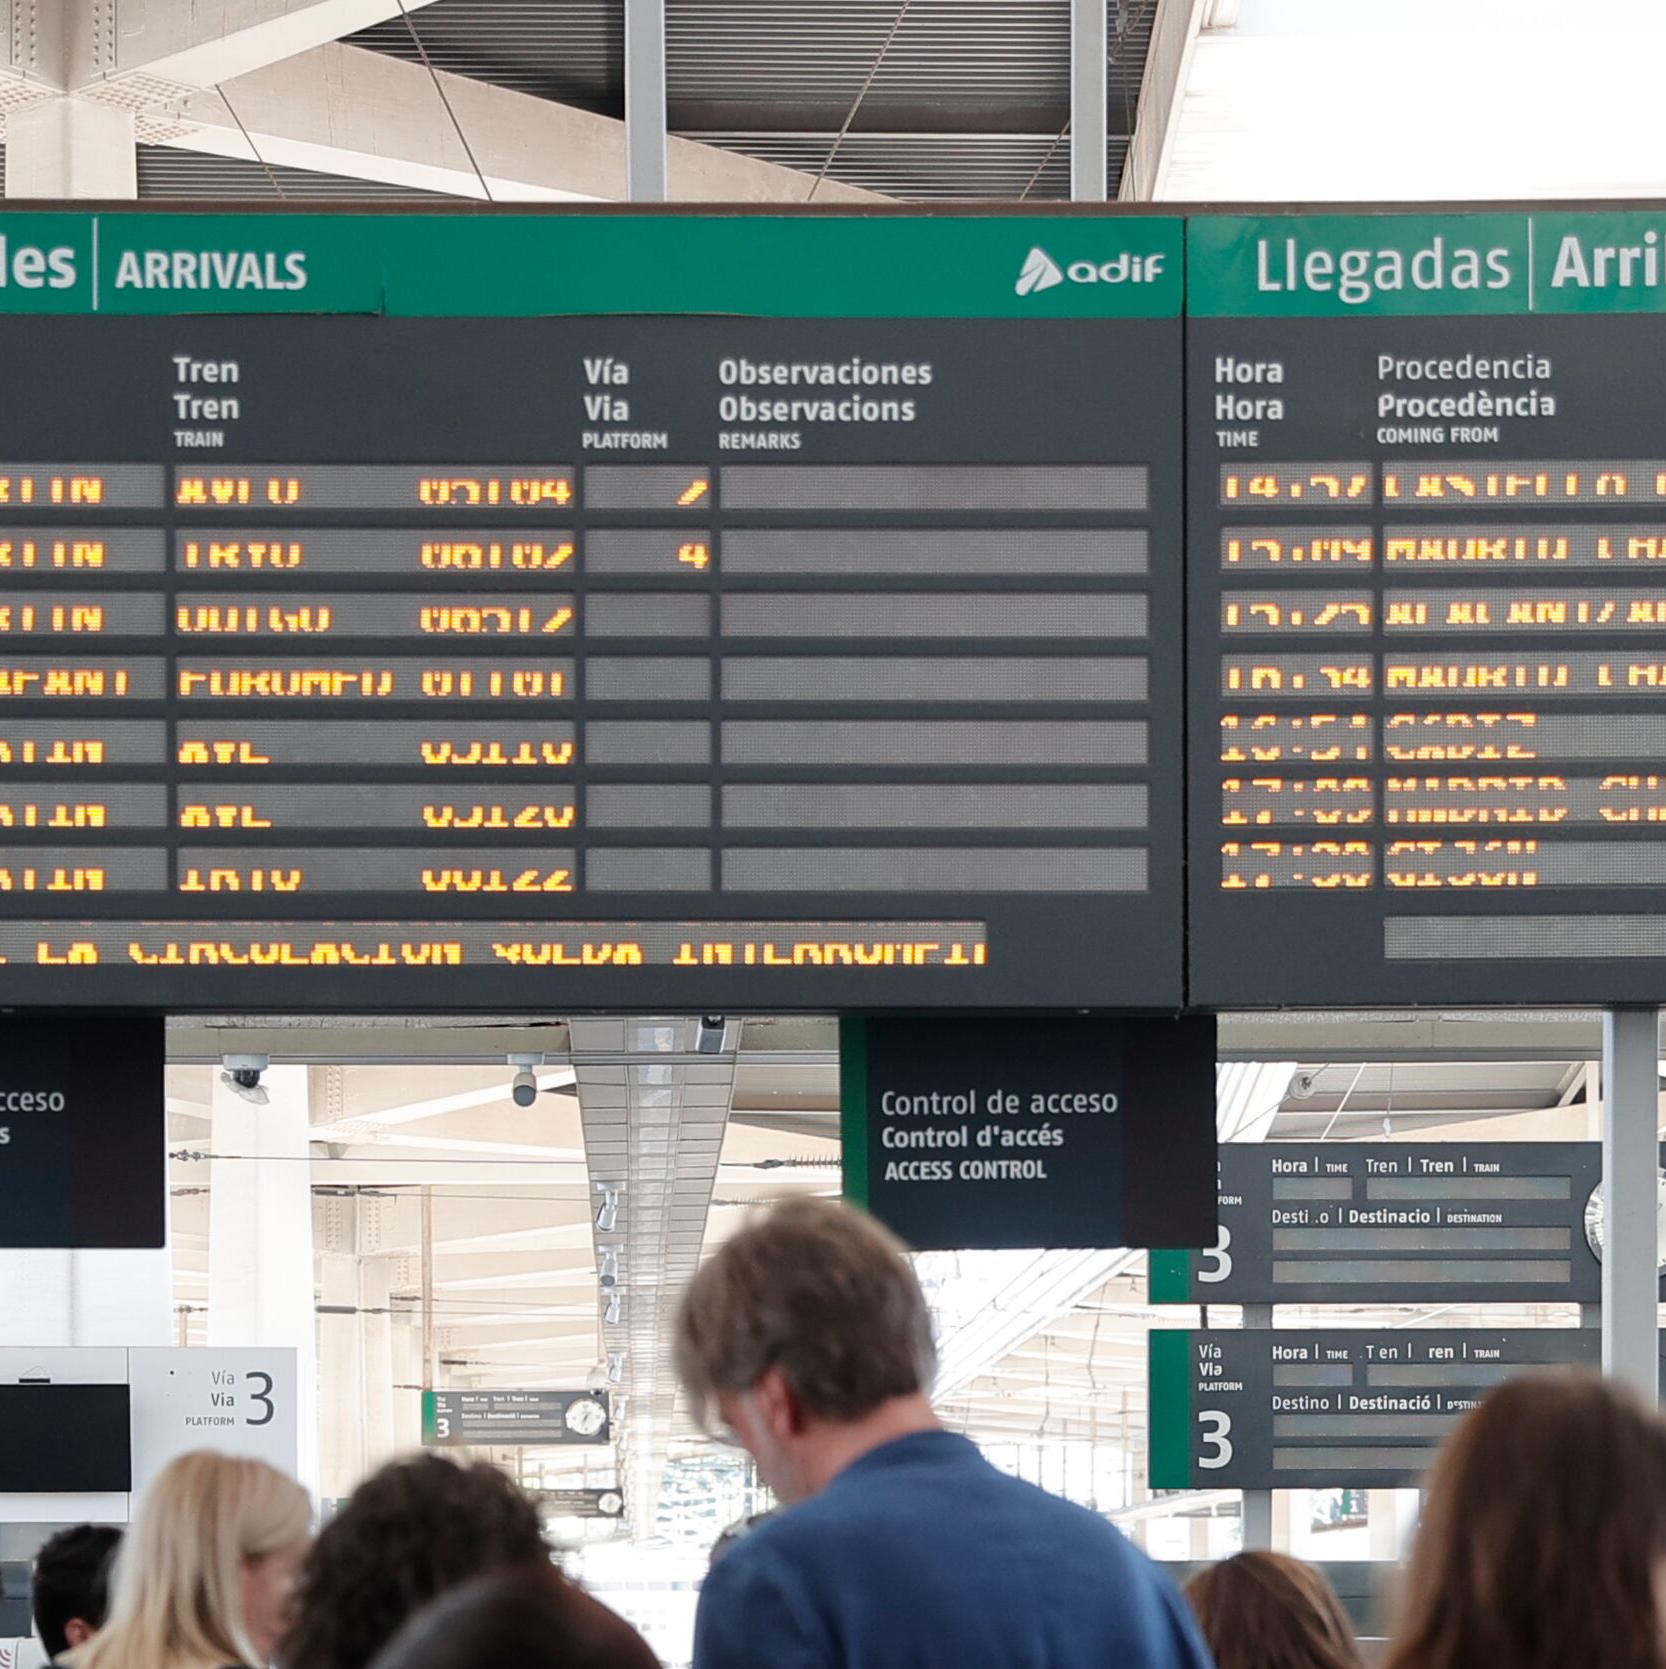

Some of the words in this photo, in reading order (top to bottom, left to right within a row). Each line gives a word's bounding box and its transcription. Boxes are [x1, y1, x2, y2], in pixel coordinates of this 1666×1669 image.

[115, 251, 307, 290] ARRIVALS
[1067, 253, 1165, 283] adif
[1257, 236, 1511, 304] Llegadas
[172, 356, 239, 383] Tren
[583, 358, 629, 385] Vía
[719, 357, 932, 385] Observaciones
[1215, 357, 1283, 383] Hora
[1378, 353, 1551, 380] Procedencia
[173, 393, 239, 420] Tren
[583, 394, 629, 421] Via
[719, 394, 915, 422] Observacions
[1215, 394, 1283, 420] Hora
[1378, 389, 1555, 418] Procedència
[173, 430, 224, 447] TRAIN
[582, 432, 668, 449] PLATFORM
[718, 432, 801, 450] REMARKS
[1215, 430, 1259, 447] TIME
[1376, 427, 1445, 444] COMING
[1450, 426, 1499, 443] FROM
[881, 1089, 976, 1116] Control
[986, 1089, 1020, 1115] de
[1030, 1093, 1118, 1114] acceso
[882, 1125, 968, 1148] Control
[976, 1122, 1064, 1147] d'accés
[884, 1160, 953, 1181] ACCESS
[959, 1159, 1047, 1180] CONTROL
[1272, 1159, 1308, 1173] Hora
[1365, 1158, 1398, 1173] Tren
[1419, 1159, 1454, 1173] Tren
[1272, 1209, 1329, 1224] Destio
[1198, 1225, 1232, 1283] 3
[1199, 1345, 1221, 1358] Vía
[1272, 1345, 1308, 1360] Hora
[1365, 1345, 1398, 1359] Ten
[1428, 1347, 1454, 1359] ren
[211, 1369, 235, 1386] Vía
[1198, 1383, 1242, 1391] PLATFORM
[210, 1391, 235, 1407] Via
[245, 1371, 274, 1426] 3
[1272, 1395, 1330, 1410] Destino
[1349, 1394, 1431, 1410] Destinació
[185, 1416, 235, 1426] PLATFORM
[1198, 1411, 1233, 1469] 3
